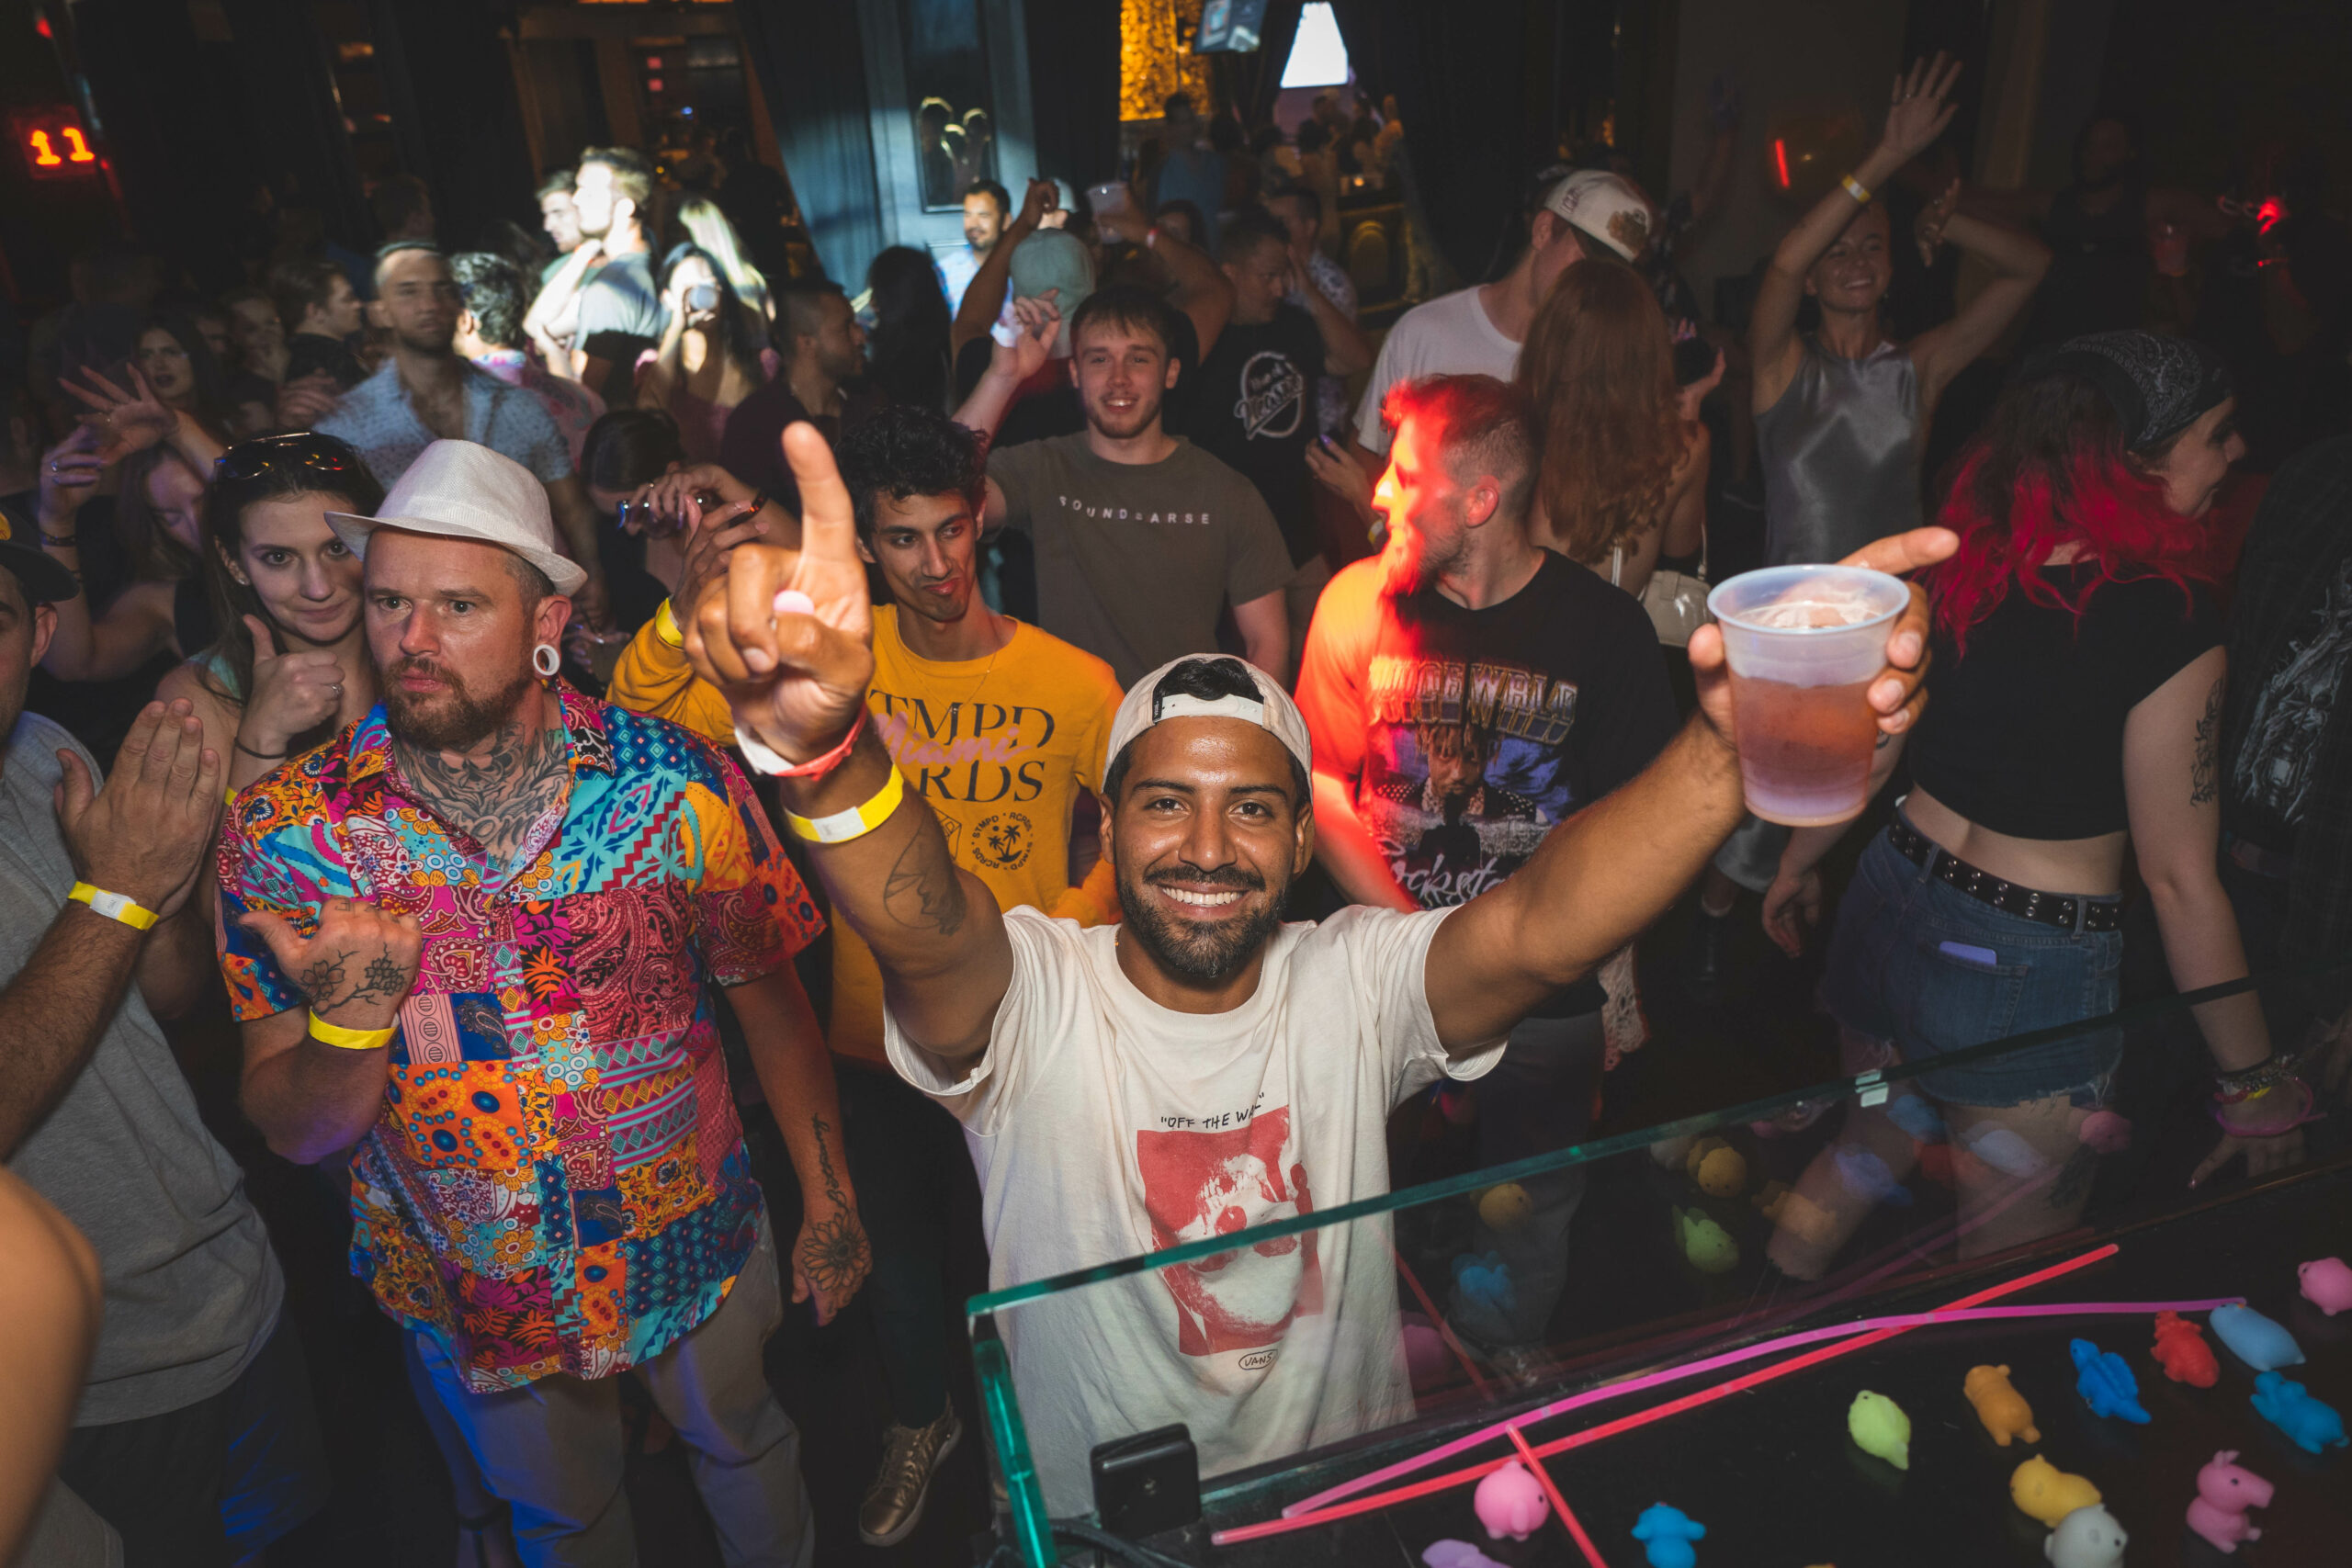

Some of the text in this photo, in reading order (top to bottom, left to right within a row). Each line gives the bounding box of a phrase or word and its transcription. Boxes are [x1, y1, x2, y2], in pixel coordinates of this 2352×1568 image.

[30, 128, 96, 166] 11
[868, 688, 1055, 750] TMPD
[1468, 661, 1578, 745] WRLD
[875, 710, 1032, 766] Miami
[919, 759, 1046, 803] RDS
[971, 814, 1000, 839] STMPD
[1202, 1111, 1230, 1130] THE
[1244, 1351, 1273, 1368] VANS
